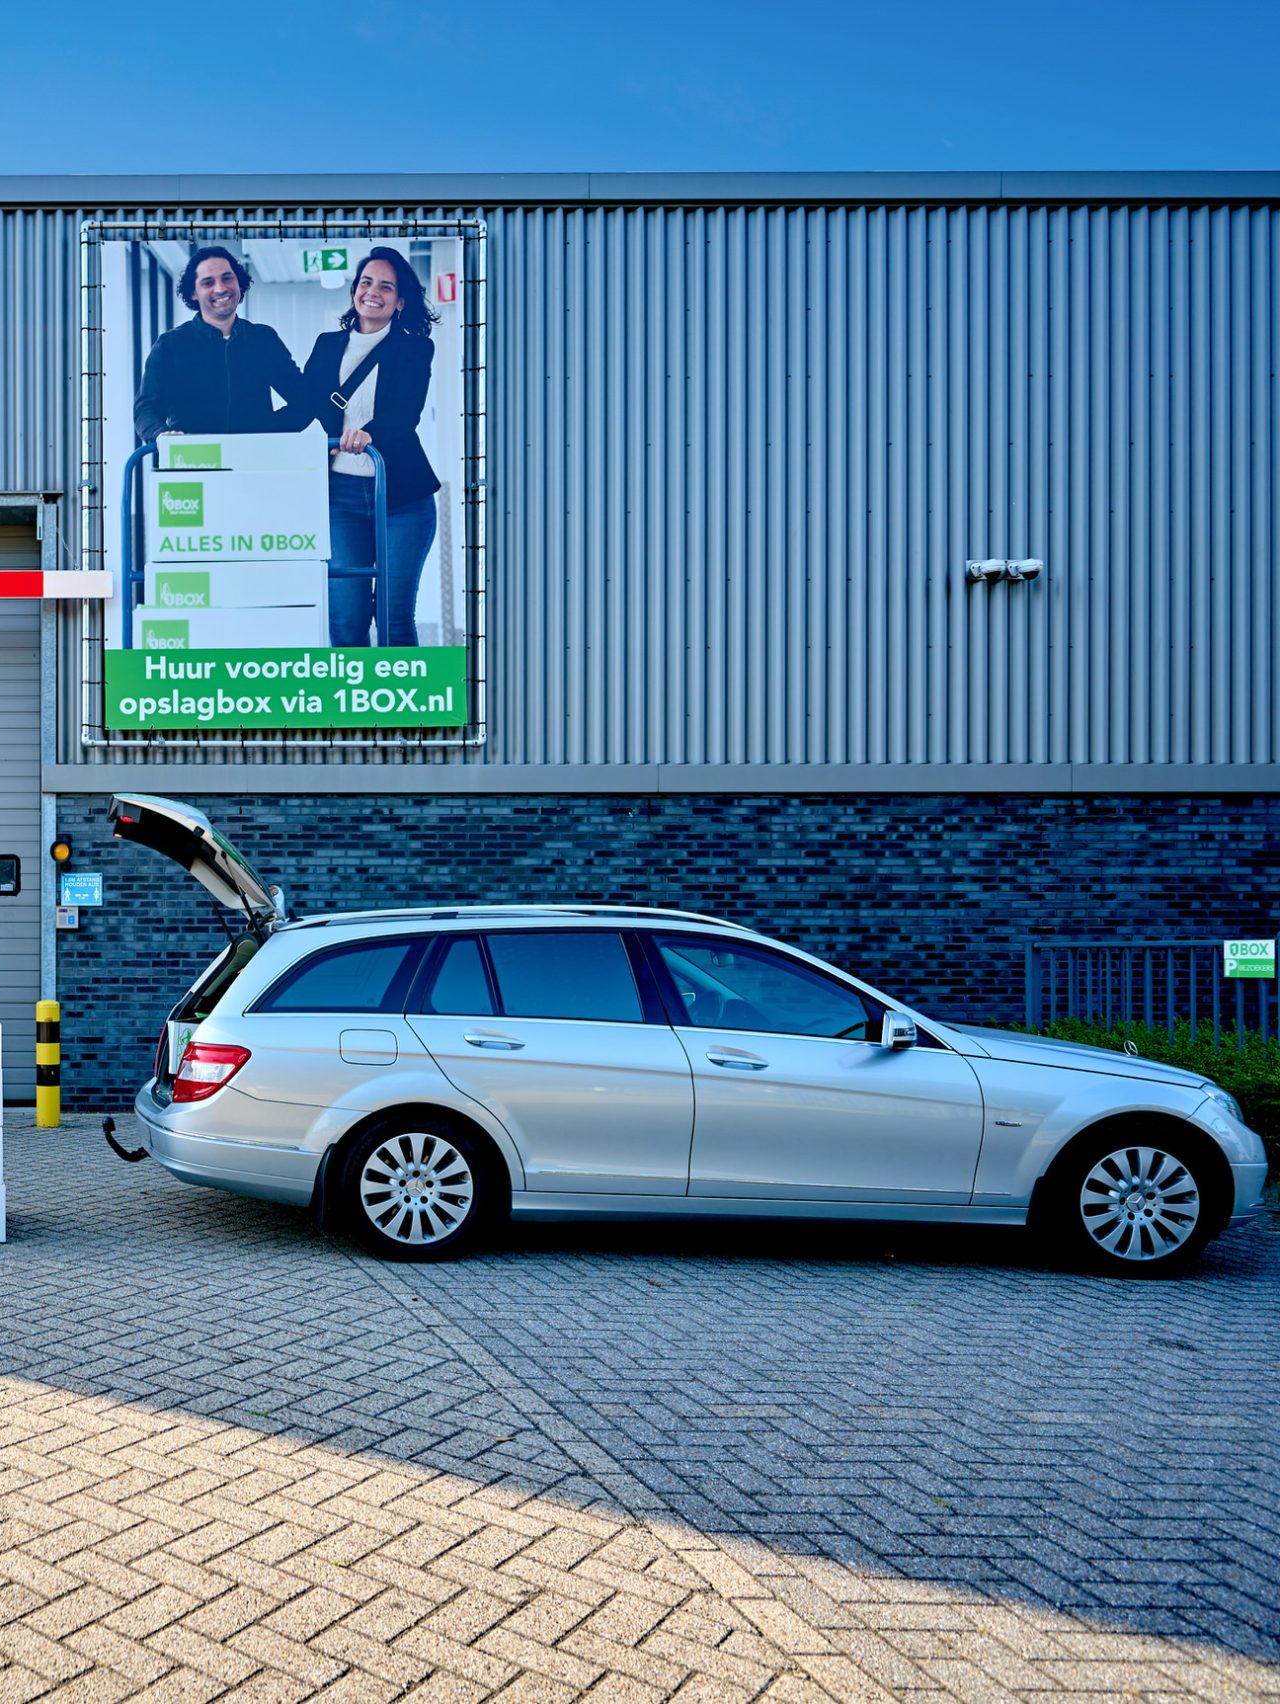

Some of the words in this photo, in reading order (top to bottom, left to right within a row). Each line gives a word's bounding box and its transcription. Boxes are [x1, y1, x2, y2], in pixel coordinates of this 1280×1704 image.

[159, 535, 223, 552] ALLES
[231, 535, 253, 551] IN
[261, 534, 316, 552] 1BOX
[145, 655, 216, 680] Huur
[225, 653, 364, 685] voordelig
[374, 660, 427, 677] een
[119, 688, 272, 721] opslagbox
[280, 689, 323, 713] via
[333, 687, 454, 713] 1BOX.nl
[1230, 943, 1269, 956] 1BOX
